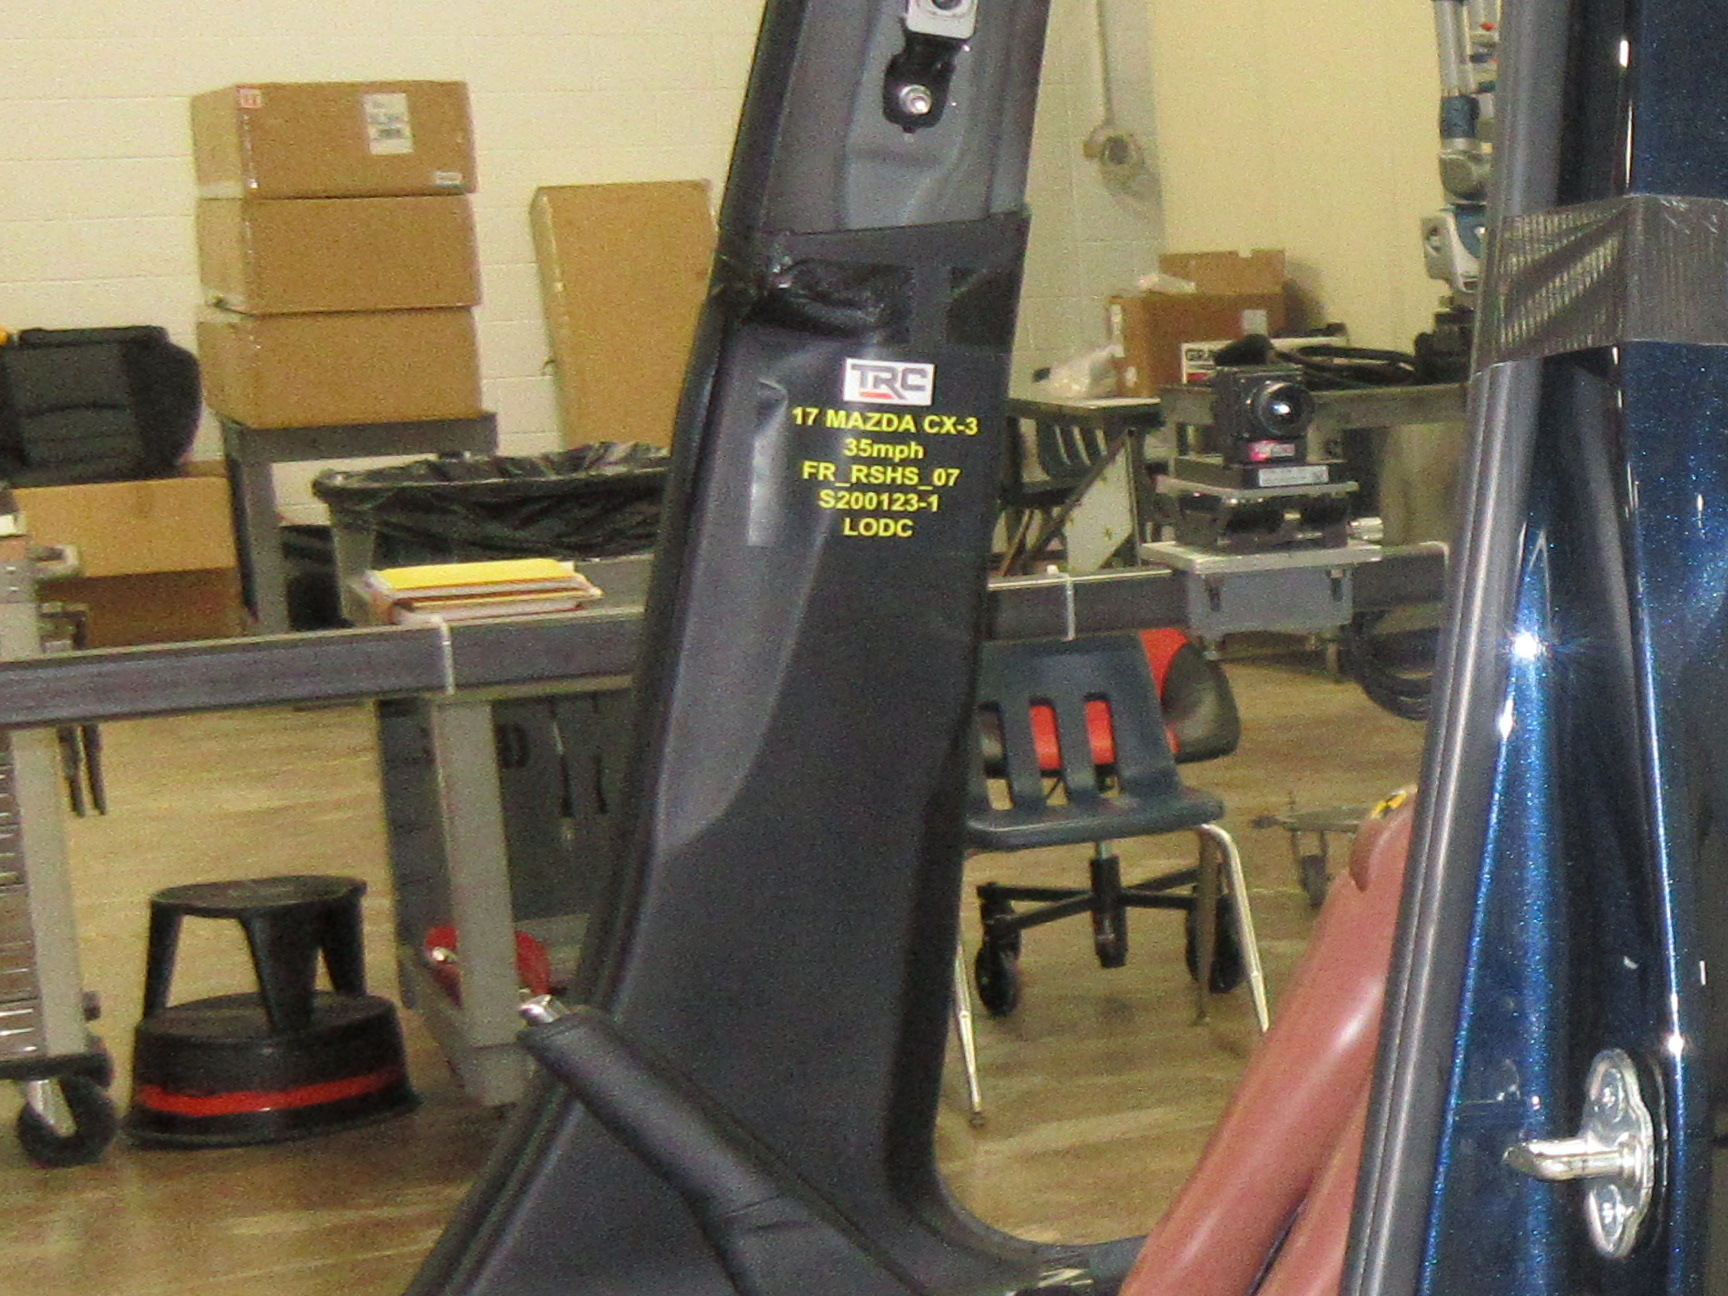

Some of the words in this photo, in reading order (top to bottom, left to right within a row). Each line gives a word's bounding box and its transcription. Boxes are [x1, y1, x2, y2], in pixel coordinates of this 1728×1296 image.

[851, 364, 928, 399] TRC
[792, 407, 819, 425] 17
[825, 409, 917, 433] MAZDA
[923, 415, 979, 435] CX-3
[843, 439, 925, 462] 35mph
[802, 460, 960, 490] FR_RSHS_07
[819, 490, 941, 512] S200123-1
[843, 517, 914, 537] LODC
